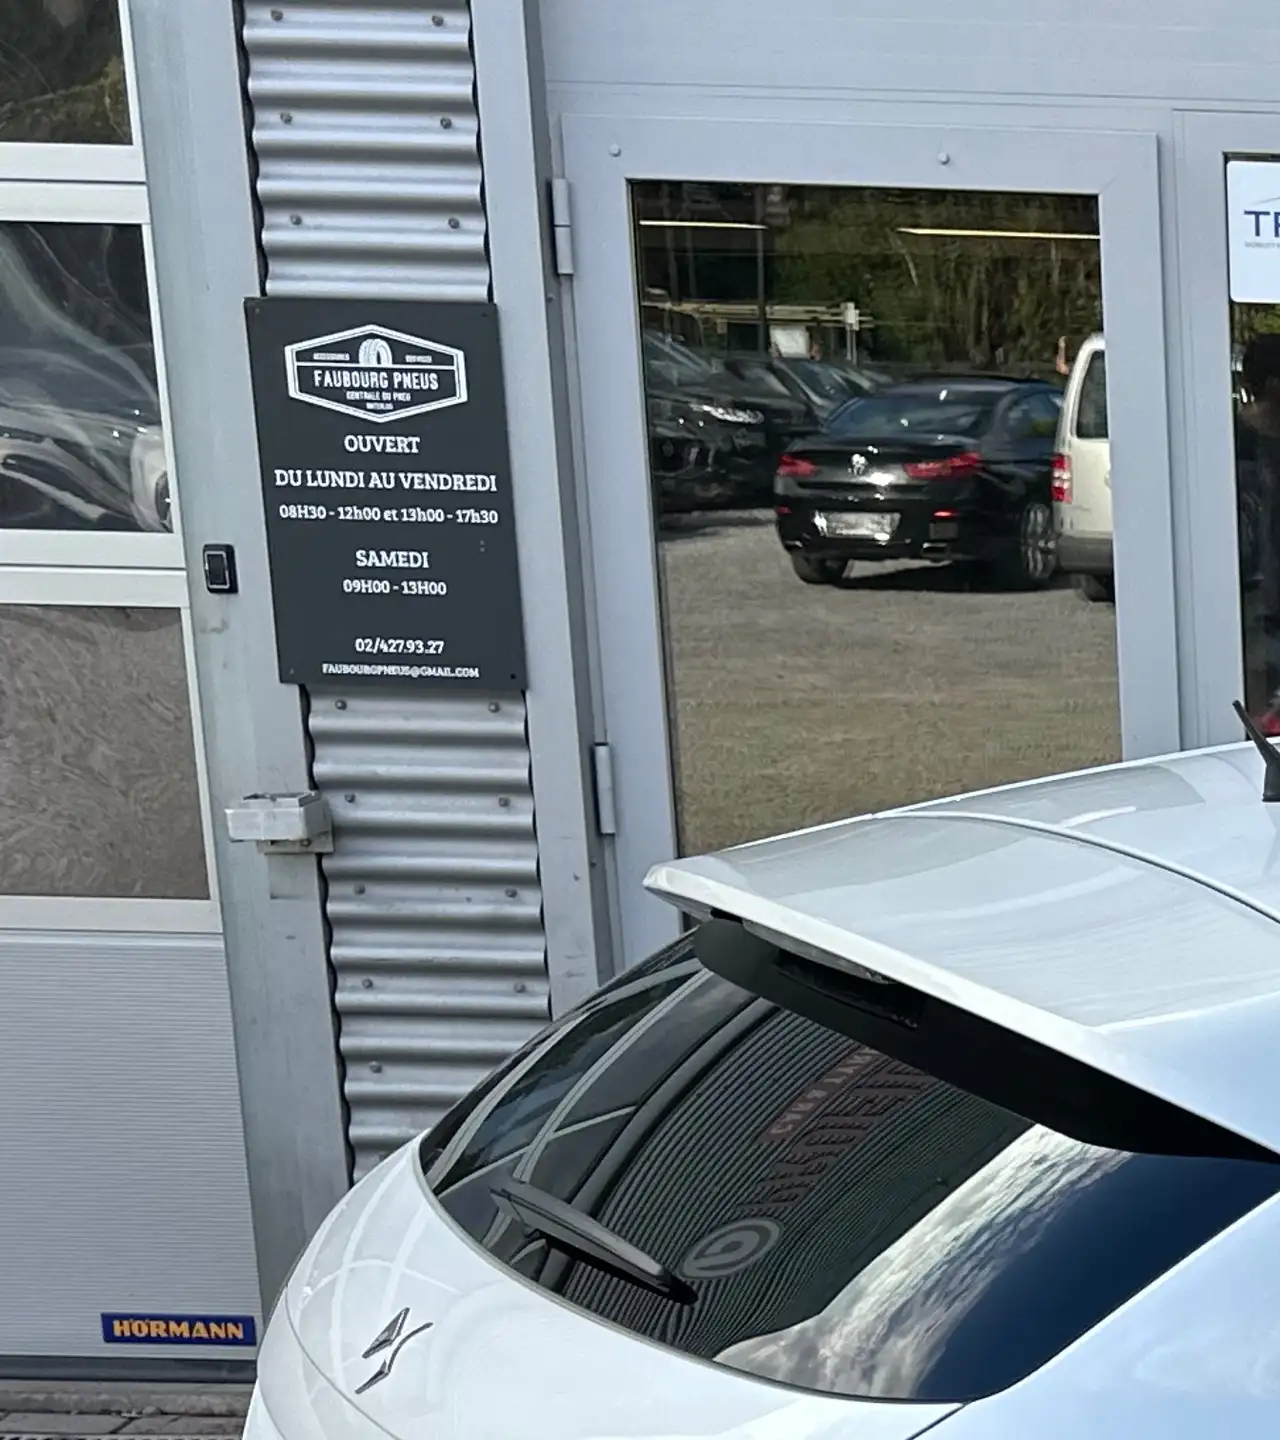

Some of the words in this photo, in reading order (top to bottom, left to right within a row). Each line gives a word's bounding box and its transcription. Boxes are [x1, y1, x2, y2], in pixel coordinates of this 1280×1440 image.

[314, 370, 388, 388] FAUBOURG
[393, 372, 438, 390] PNEUS
[344, 435, 420, 453] OUVERT
[274, 470, 302, 485] DU
[307, 470, 365, 487] LUNDI
[368, 472, 395, 488] AU
[398, 473, 497, 491] VENDREDI
[280, 505, 326, 519] 08H30
[338, 506, 381, 520] 12h00
[384, 509, 399, 521] et
[401, 507, 444, 522] 13h00
[456, 509, 498, 523] 17h30
[356, 550, 429, 568] SAMEDI
[343, 579, 390, 593] 09H00
[401, 581, 446, 595] 13H00
[113, 1318, 243, 1339] HÖRMANN
